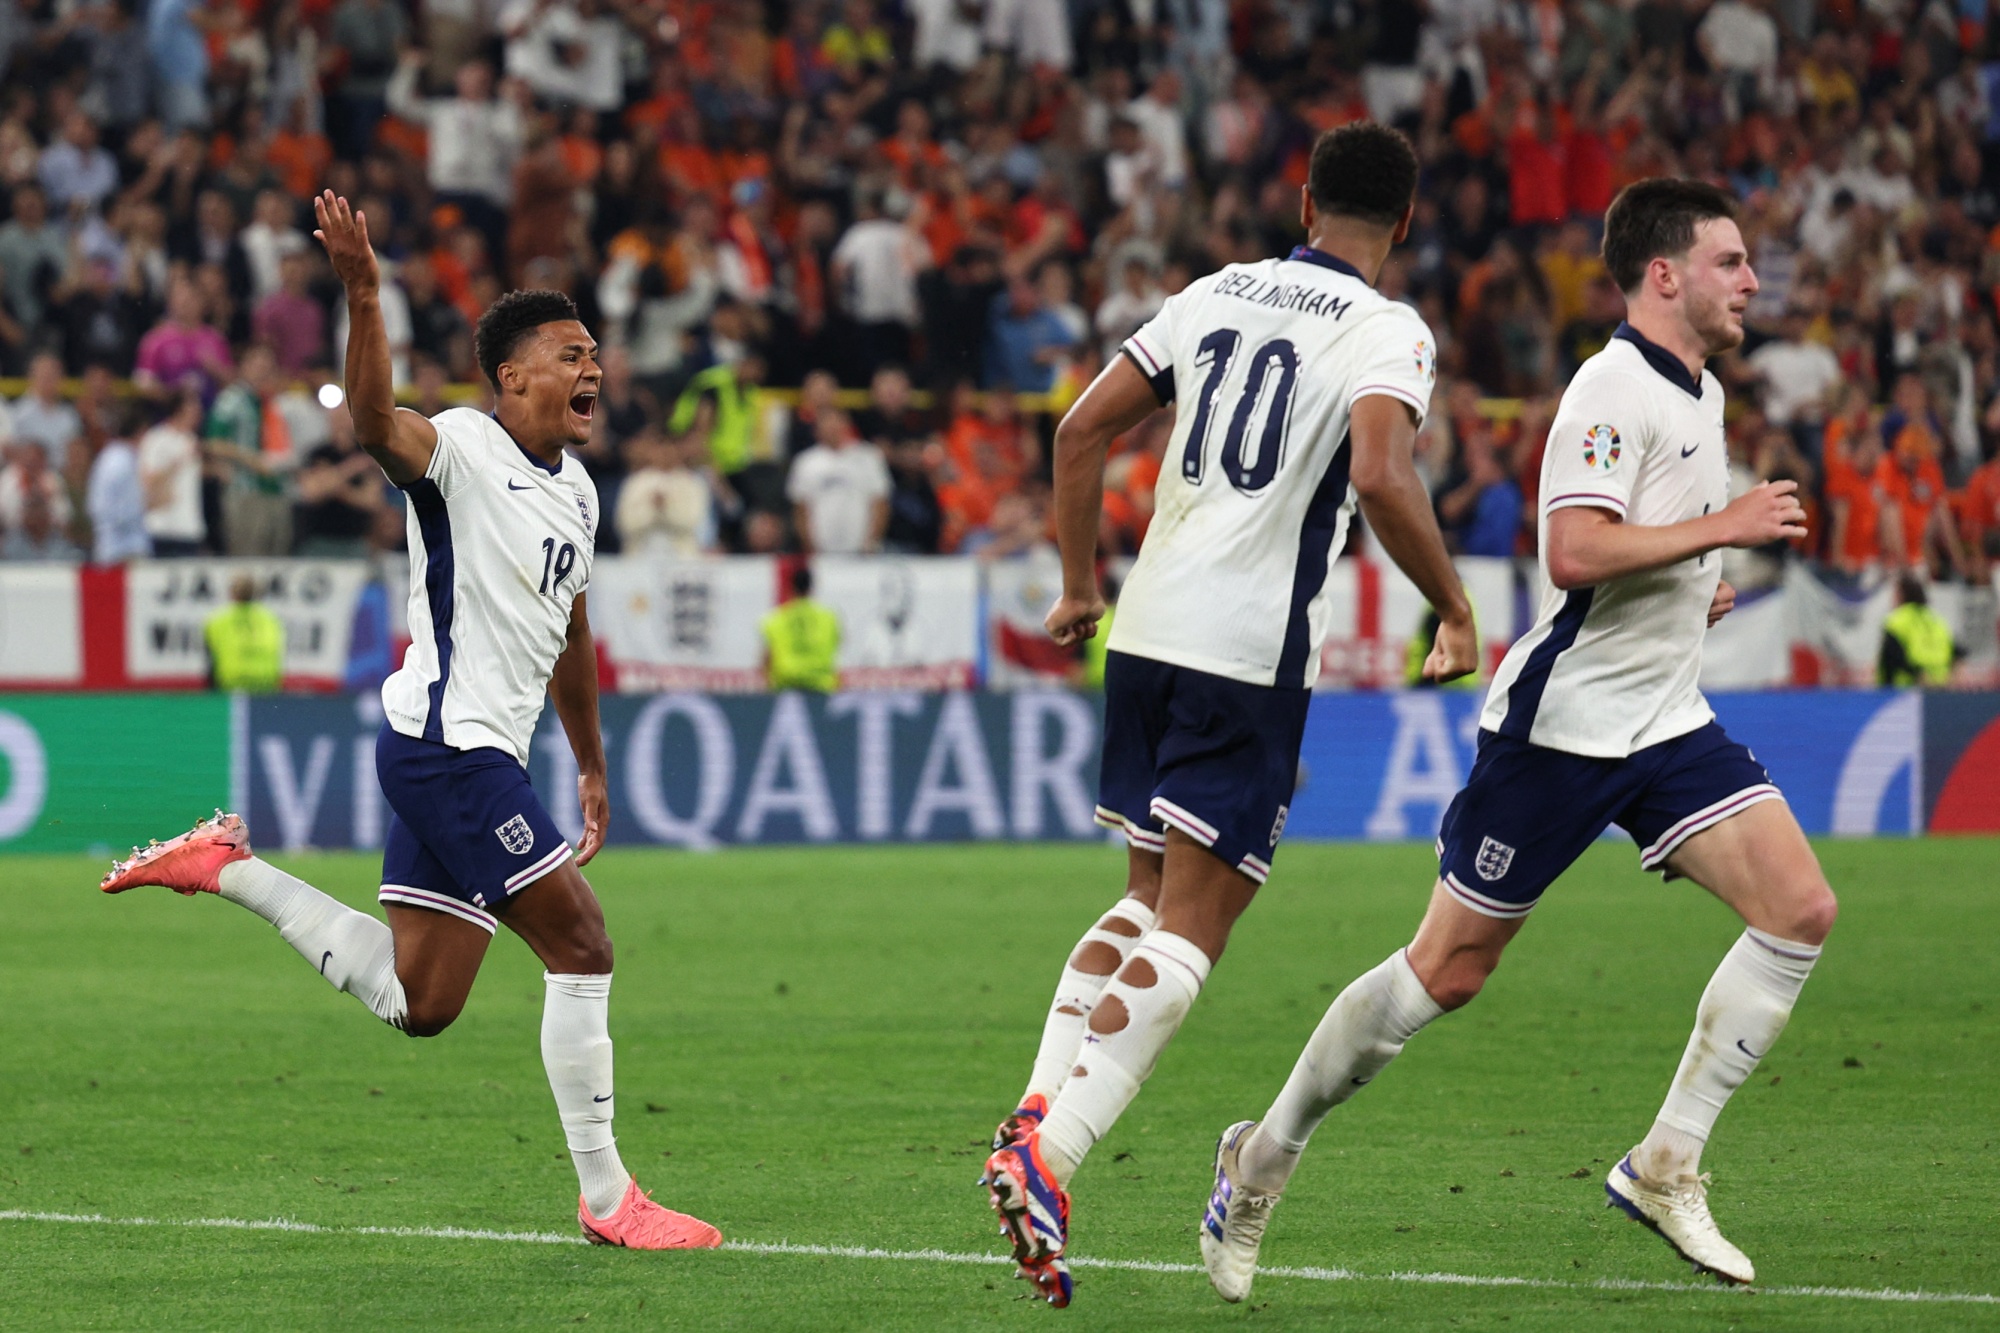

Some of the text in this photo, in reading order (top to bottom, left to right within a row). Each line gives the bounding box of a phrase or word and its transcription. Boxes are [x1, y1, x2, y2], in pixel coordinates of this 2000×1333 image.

[1213, 271, 1353, 322] BELLINGHAM
[1182, 327, 1303, 498] 10
[538, 536, 577, 599] 19
